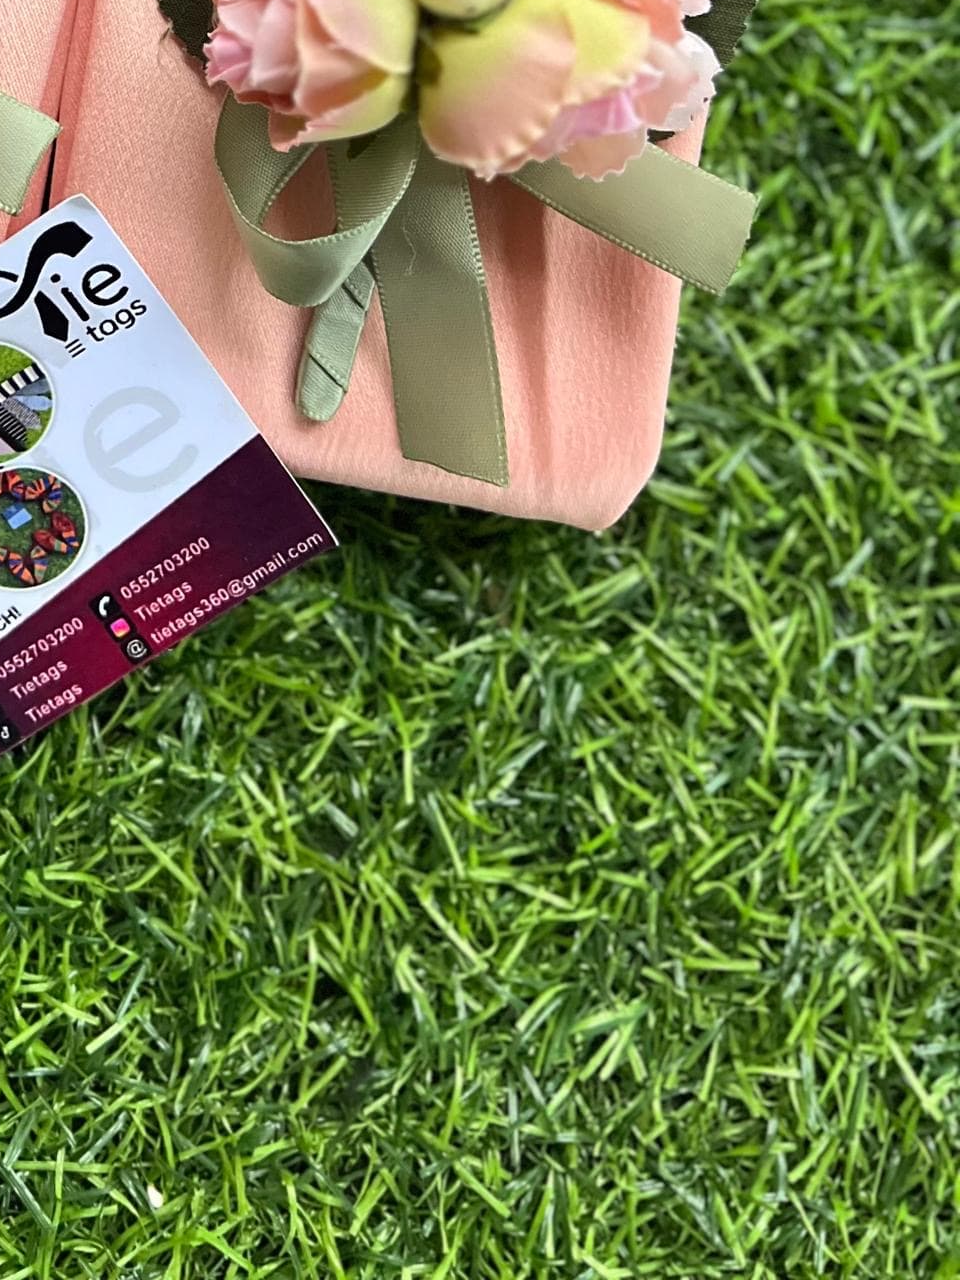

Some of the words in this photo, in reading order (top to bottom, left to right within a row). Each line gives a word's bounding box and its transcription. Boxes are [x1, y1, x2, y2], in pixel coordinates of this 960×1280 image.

[86, 299, 147, 342] tags
[120, 536, 211, 599] 0552703200
[150, 532, 324, 644] tietags360@gmail.com
[134, 580, 192, 621] Tietags
[9, 660, 68, 700] Tietags
[24, 683, 83, 722] Tietags
